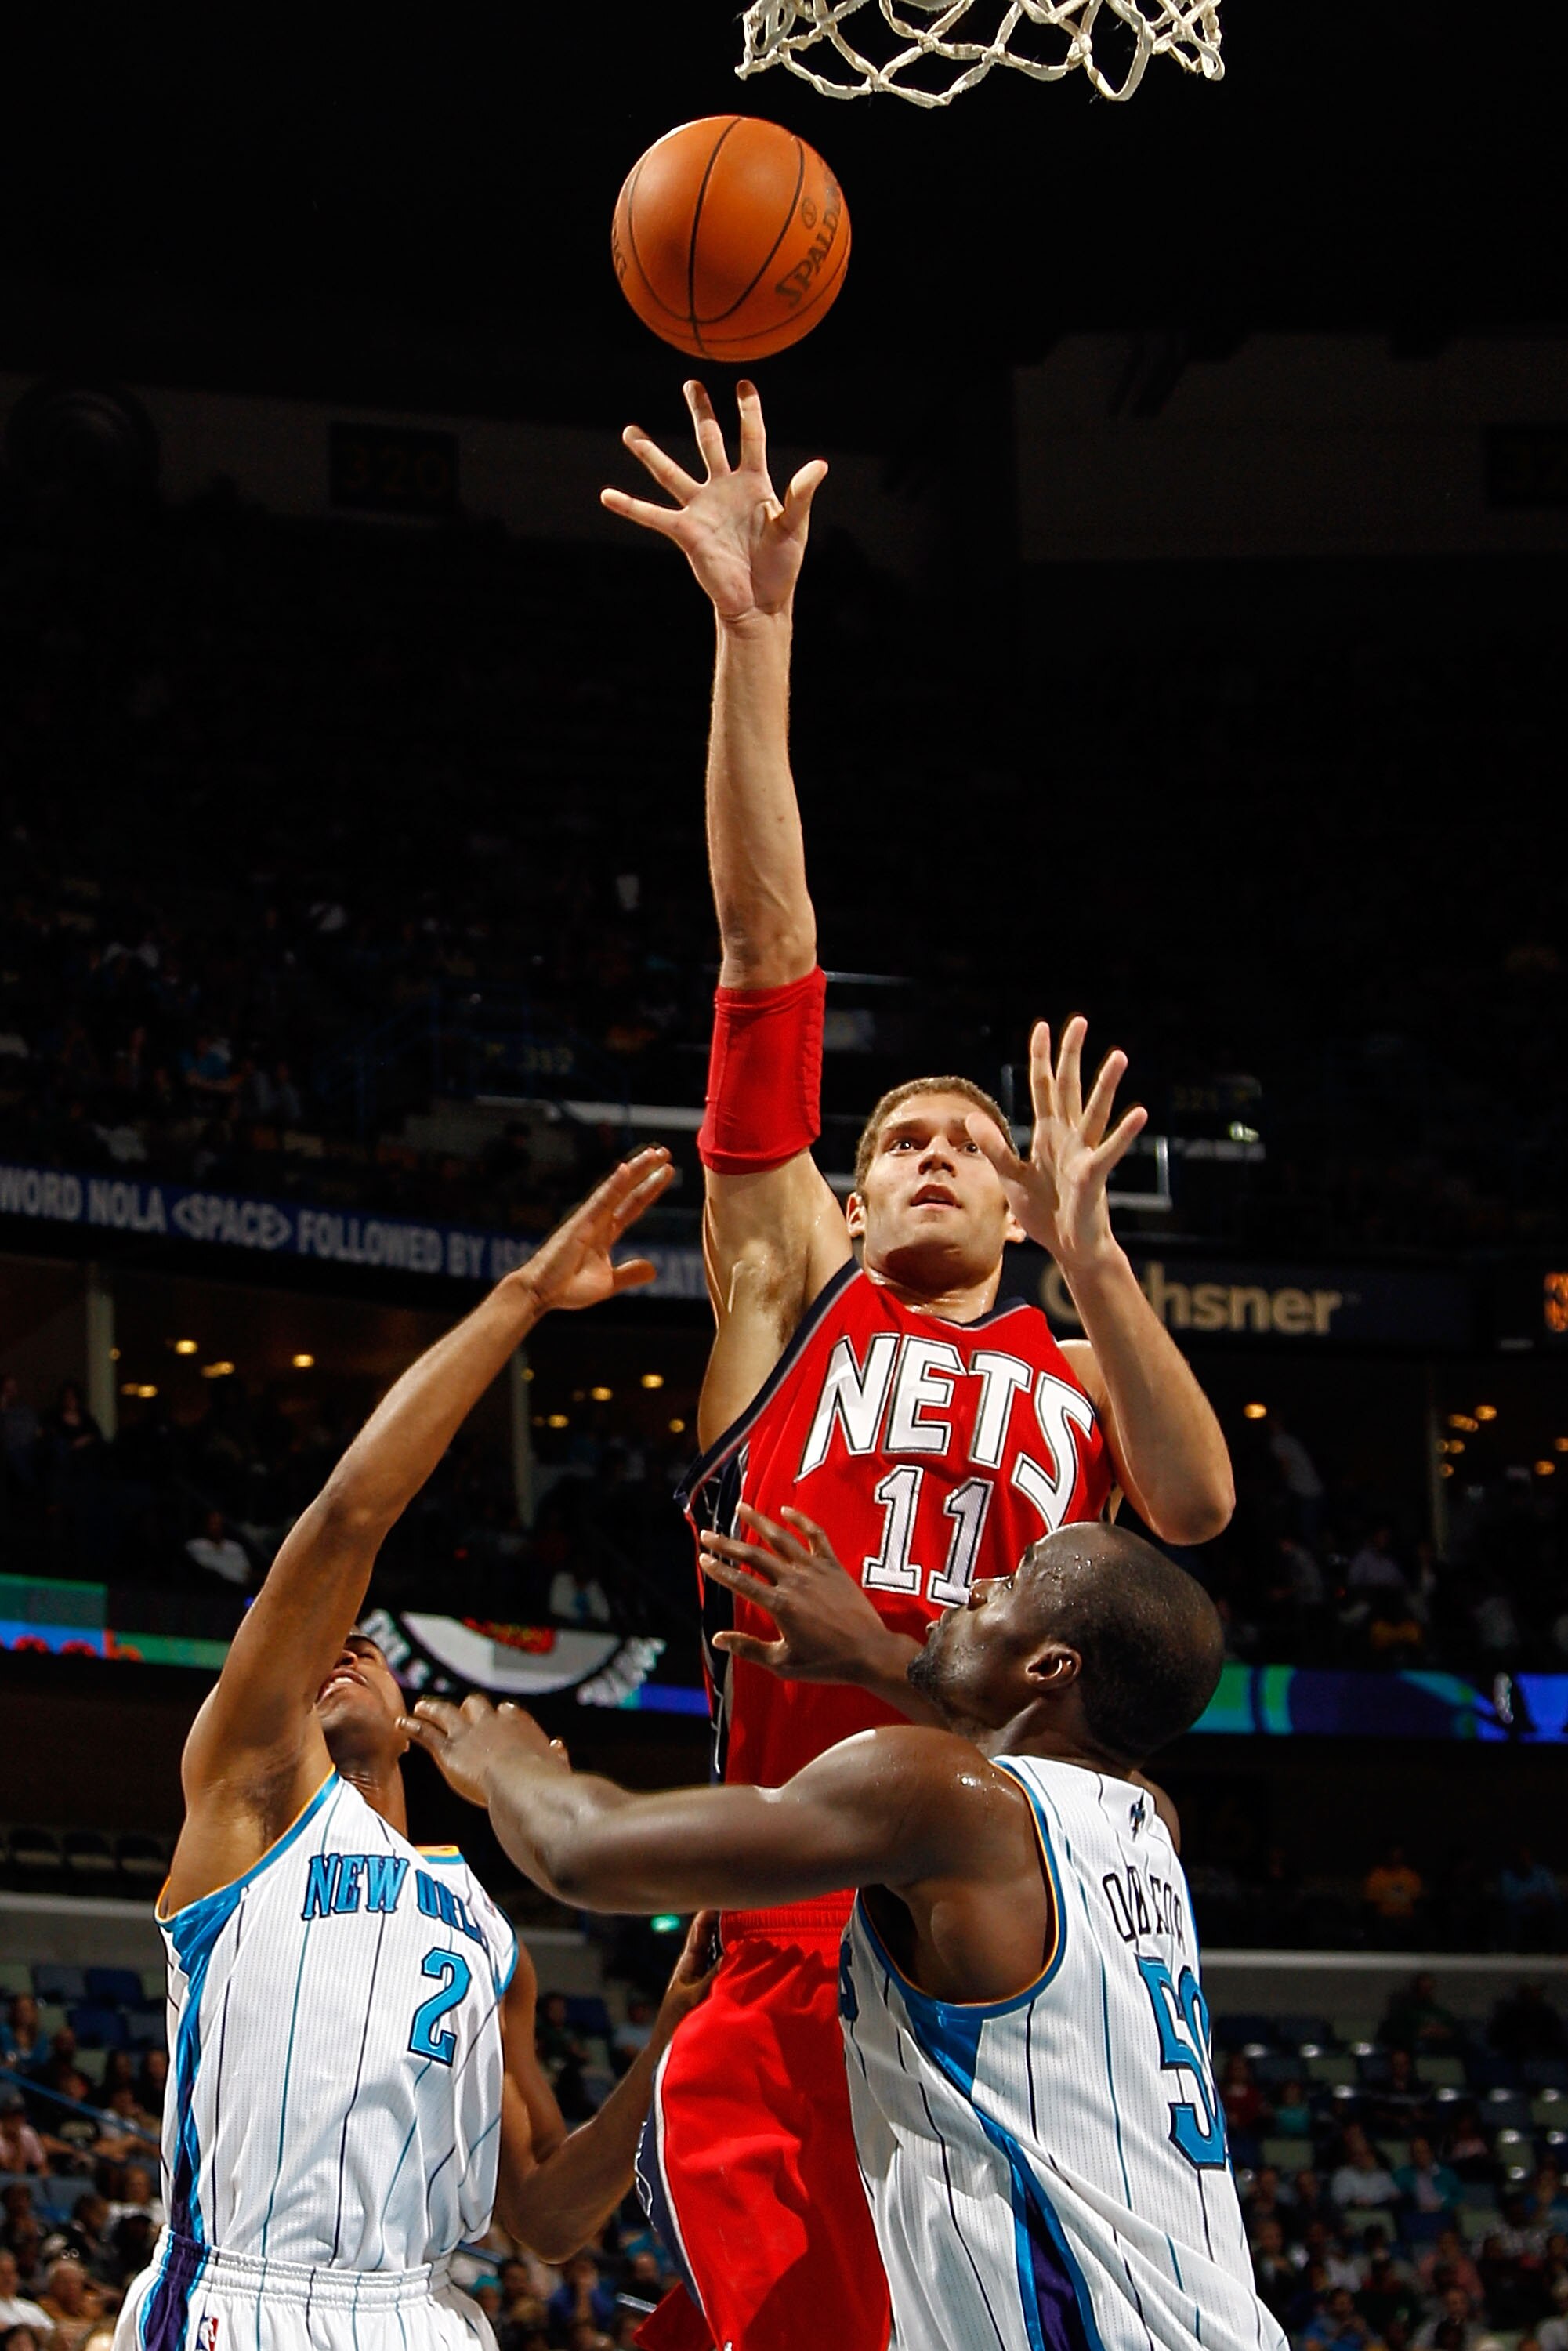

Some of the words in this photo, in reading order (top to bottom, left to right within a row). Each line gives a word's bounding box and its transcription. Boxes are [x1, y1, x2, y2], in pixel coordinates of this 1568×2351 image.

[88, 1179, 168, 1235] NOLA
[296, 1208, 444, 1275] FOLLOWED
[447, 1230, 486, 1279] BY
[1039, 1260, 1343, 1337] Ohsner
[794, 1332, 1096, 1534] NETS
[862, 1464, 994, 1608] 11
[301, 1853, 410, 1921] NEW
[408, 1947, 473, 2067] 2
